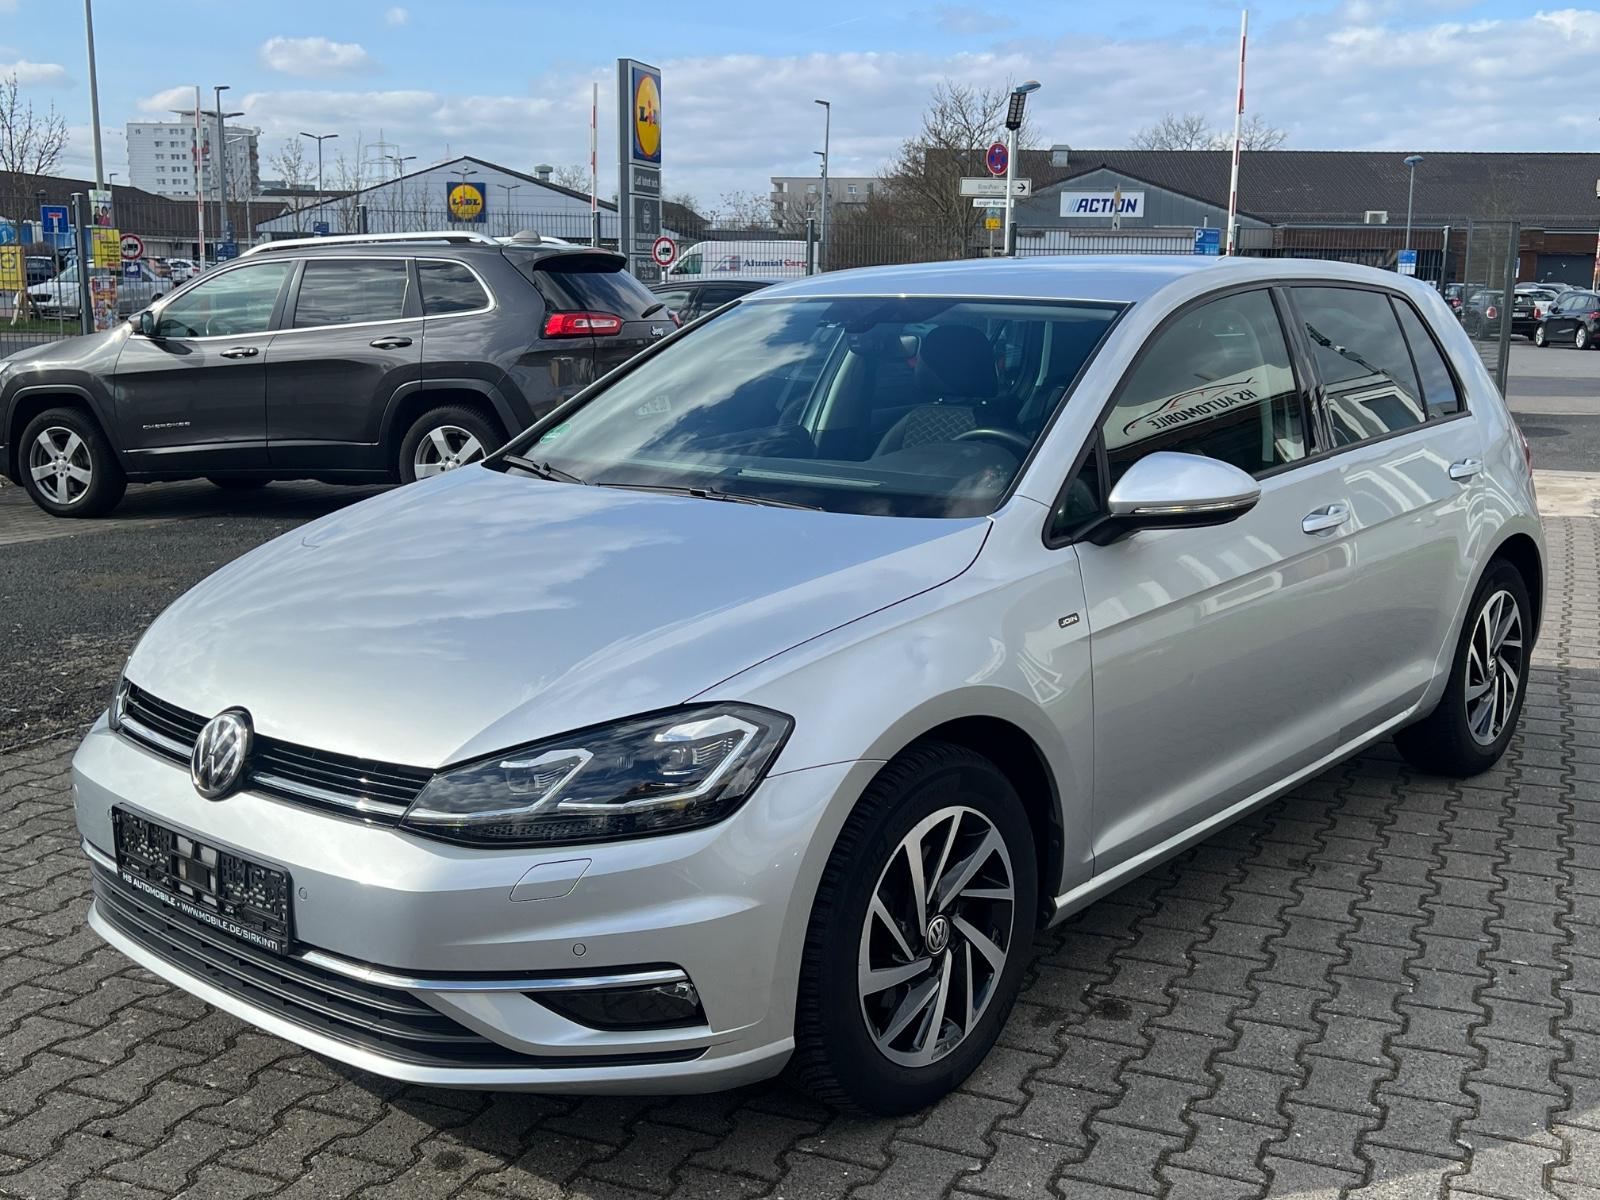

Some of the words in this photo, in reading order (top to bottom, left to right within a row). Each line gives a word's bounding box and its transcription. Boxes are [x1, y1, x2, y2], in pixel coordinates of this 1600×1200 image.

[1076, 198, 1138, 213] ACTION
[1196, 230, 1204, 242] P
[783, 260, 808, 268] Carg
[1061, 615, 1078, 626] JOIN
[122, 872, 132, 884] HS
[133, 878, 176, 906] AUTOMOBILE
[927, 917, 949, 955] VW
